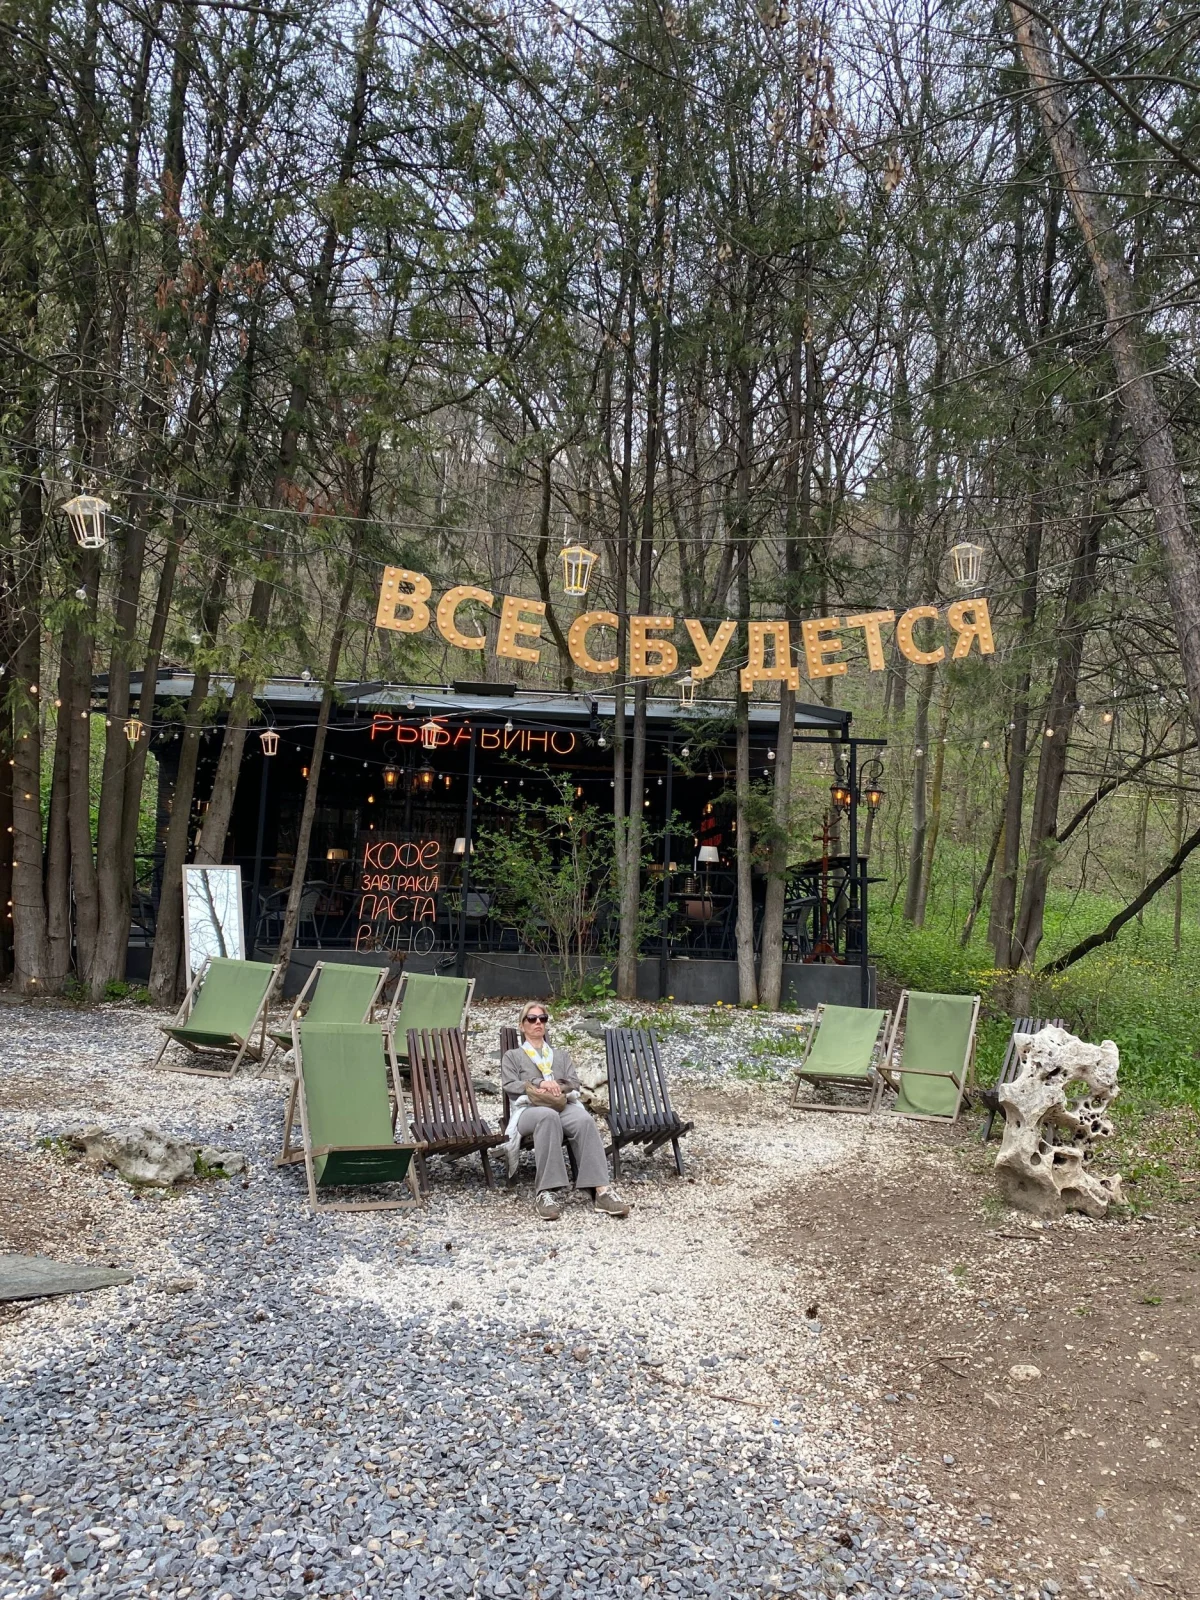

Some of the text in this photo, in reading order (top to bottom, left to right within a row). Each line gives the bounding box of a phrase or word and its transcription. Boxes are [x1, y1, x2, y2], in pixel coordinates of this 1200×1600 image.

[375, 566, 995, 693] ВСЕ СБУДЕТСЯ
[361, 874, 439, 892] ЗАВТРАКИ
[358, 894, 436, 922] ПАСТА
[355, 924, 436, 956] ВИНО
